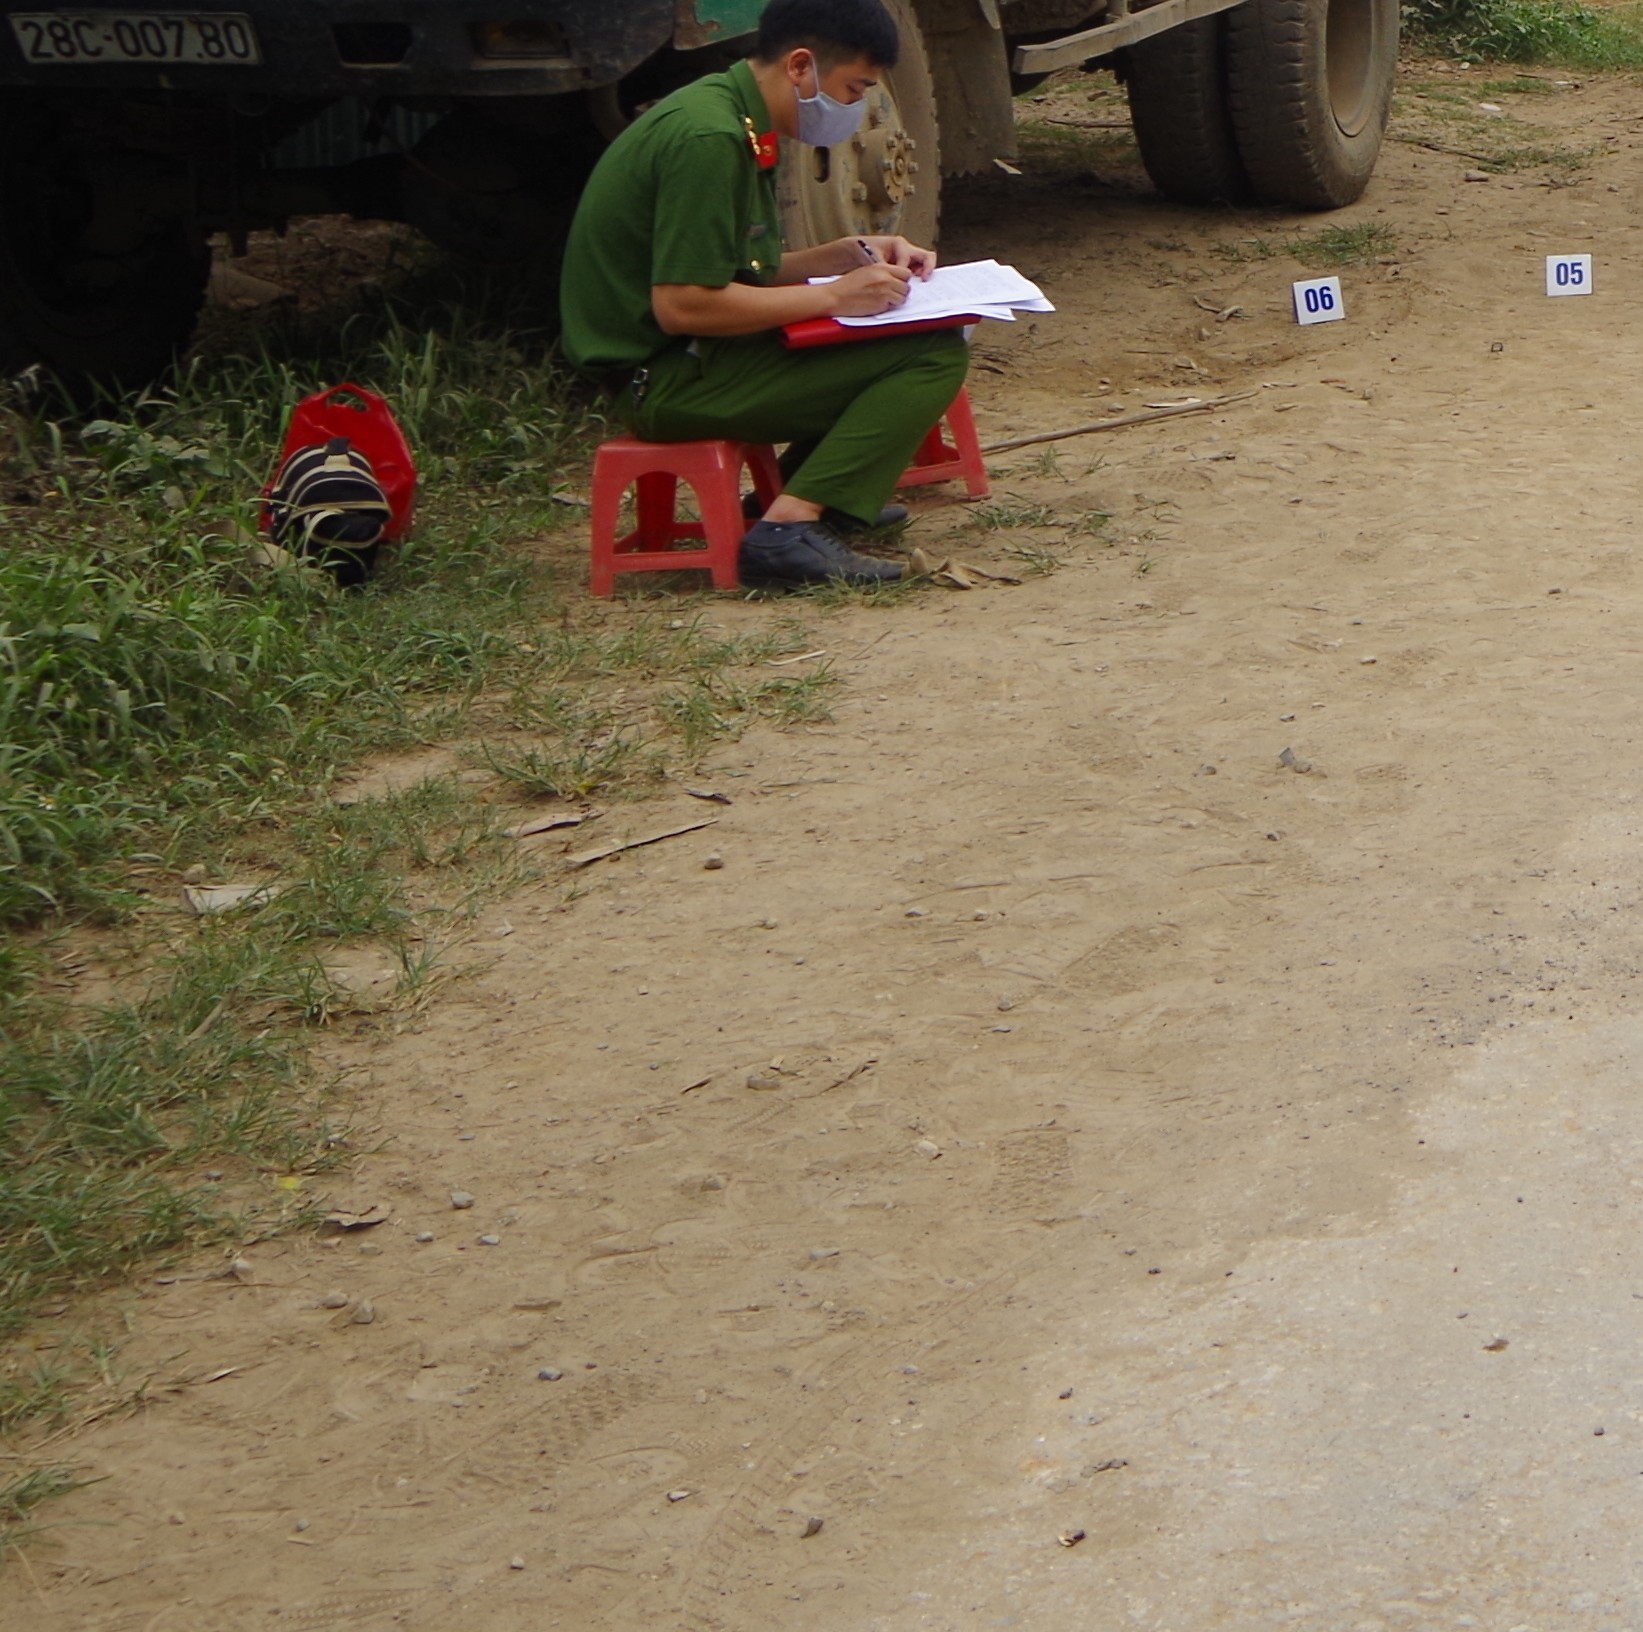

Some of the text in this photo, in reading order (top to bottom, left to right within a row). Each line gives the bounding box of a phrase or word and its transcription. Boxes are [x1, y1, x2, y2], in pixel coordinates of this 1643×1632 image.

[20, 19, 250, 59] 28C-007.80
[1556, 261, 1583, 286] 05
[1304, 285, 1334, 313] 06
